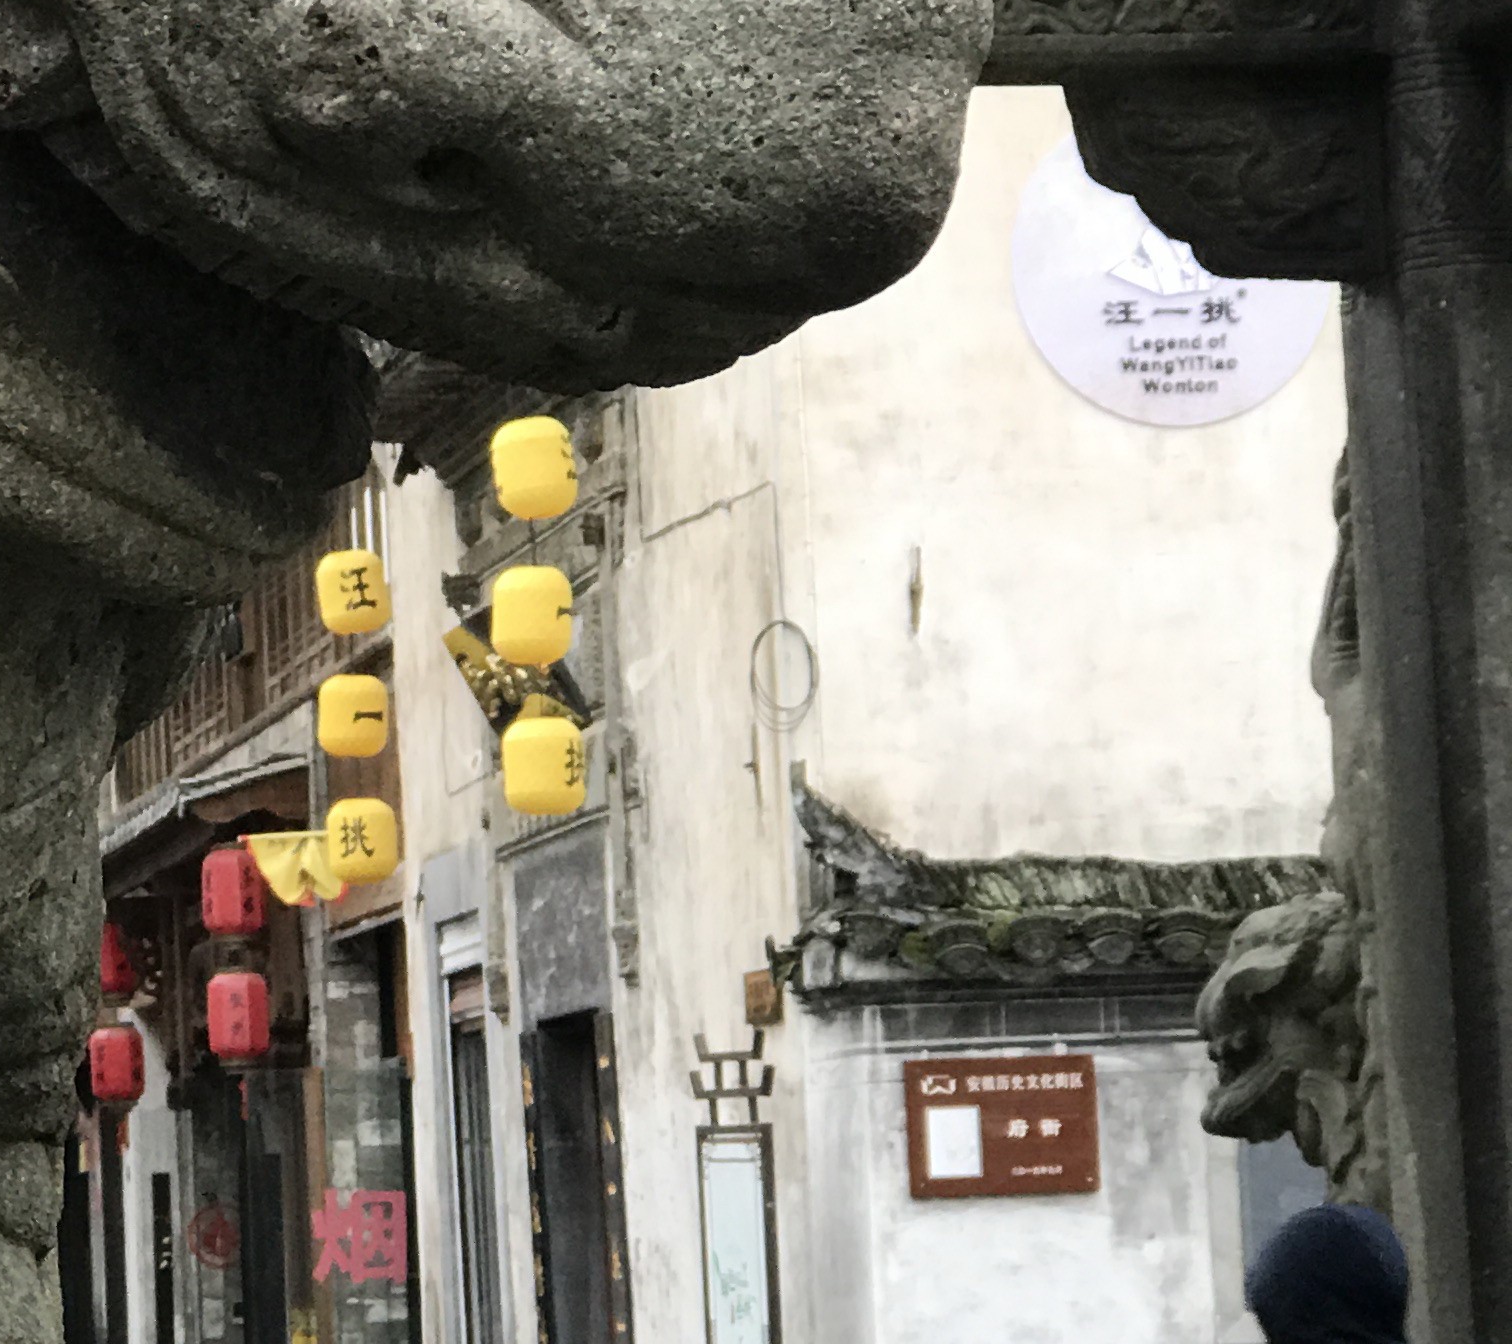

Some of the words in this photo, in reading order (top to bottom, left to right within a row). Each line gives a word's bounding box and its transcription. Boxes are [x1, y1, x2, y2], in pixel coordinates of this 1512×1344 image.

[1129, 335, 1202, 353] Legend
[1208, 333, 1227, 349] of
[341, 567, 377, 611] 汪
[340, 816, 374, 857] 挑
[311, 1187, 407, 1284] 烟
